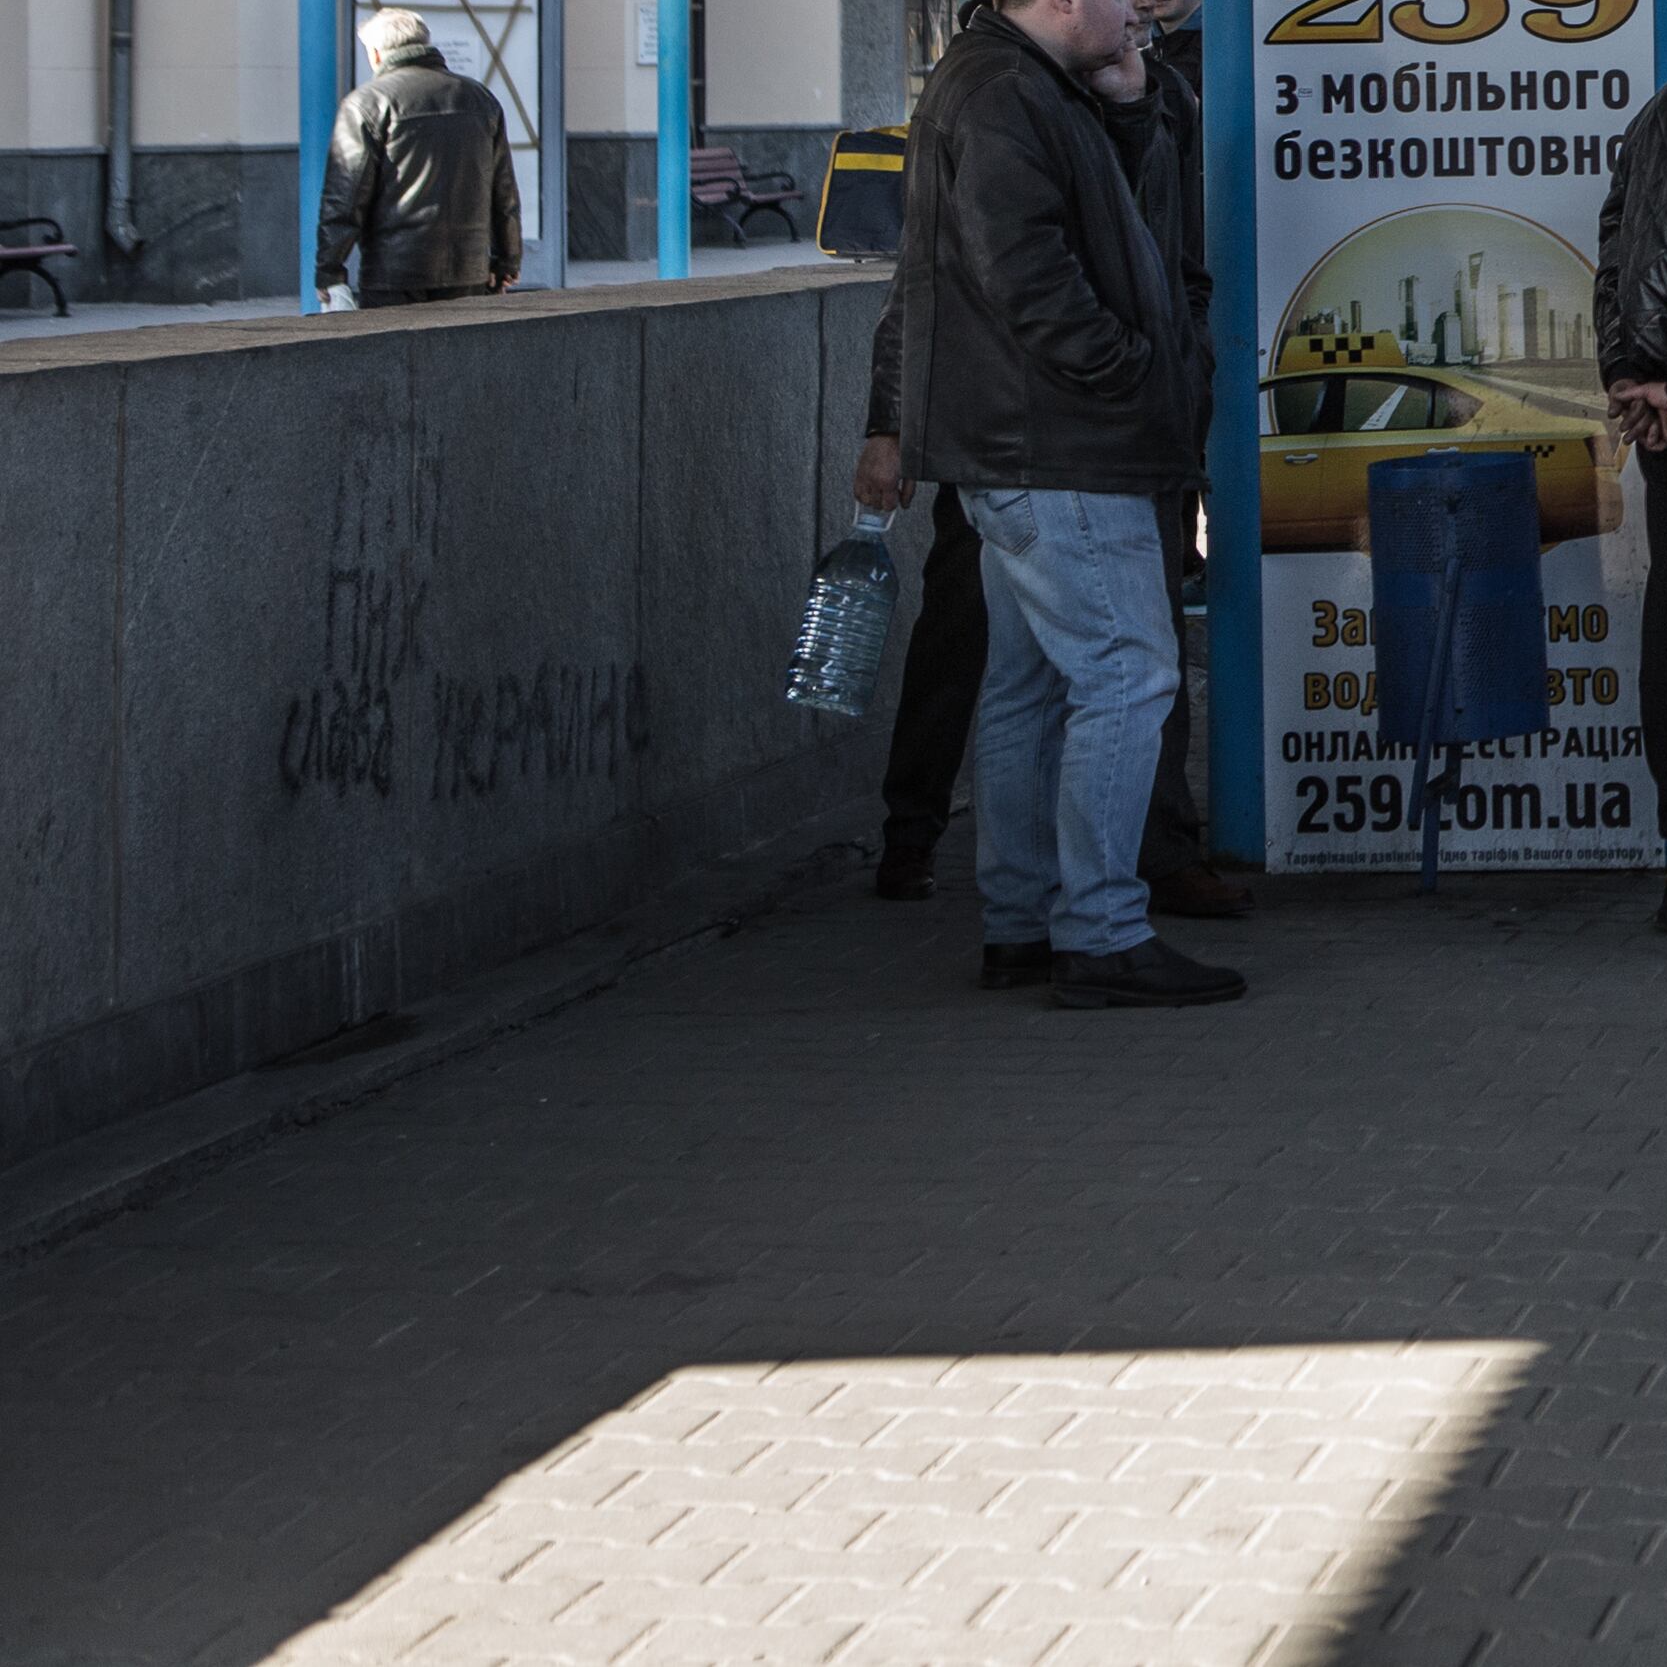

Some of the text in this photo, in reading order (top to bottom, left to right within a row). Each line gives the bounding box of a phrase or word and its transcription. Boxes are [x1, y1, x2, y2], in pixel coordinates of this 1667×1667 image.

[1322, 61, 1630, 115] мобільного
[1547, 667, 1619, 708] вто
[1523, 846, 1572, 861] Вашого
[1576, 845, 1644, 862] оператору
